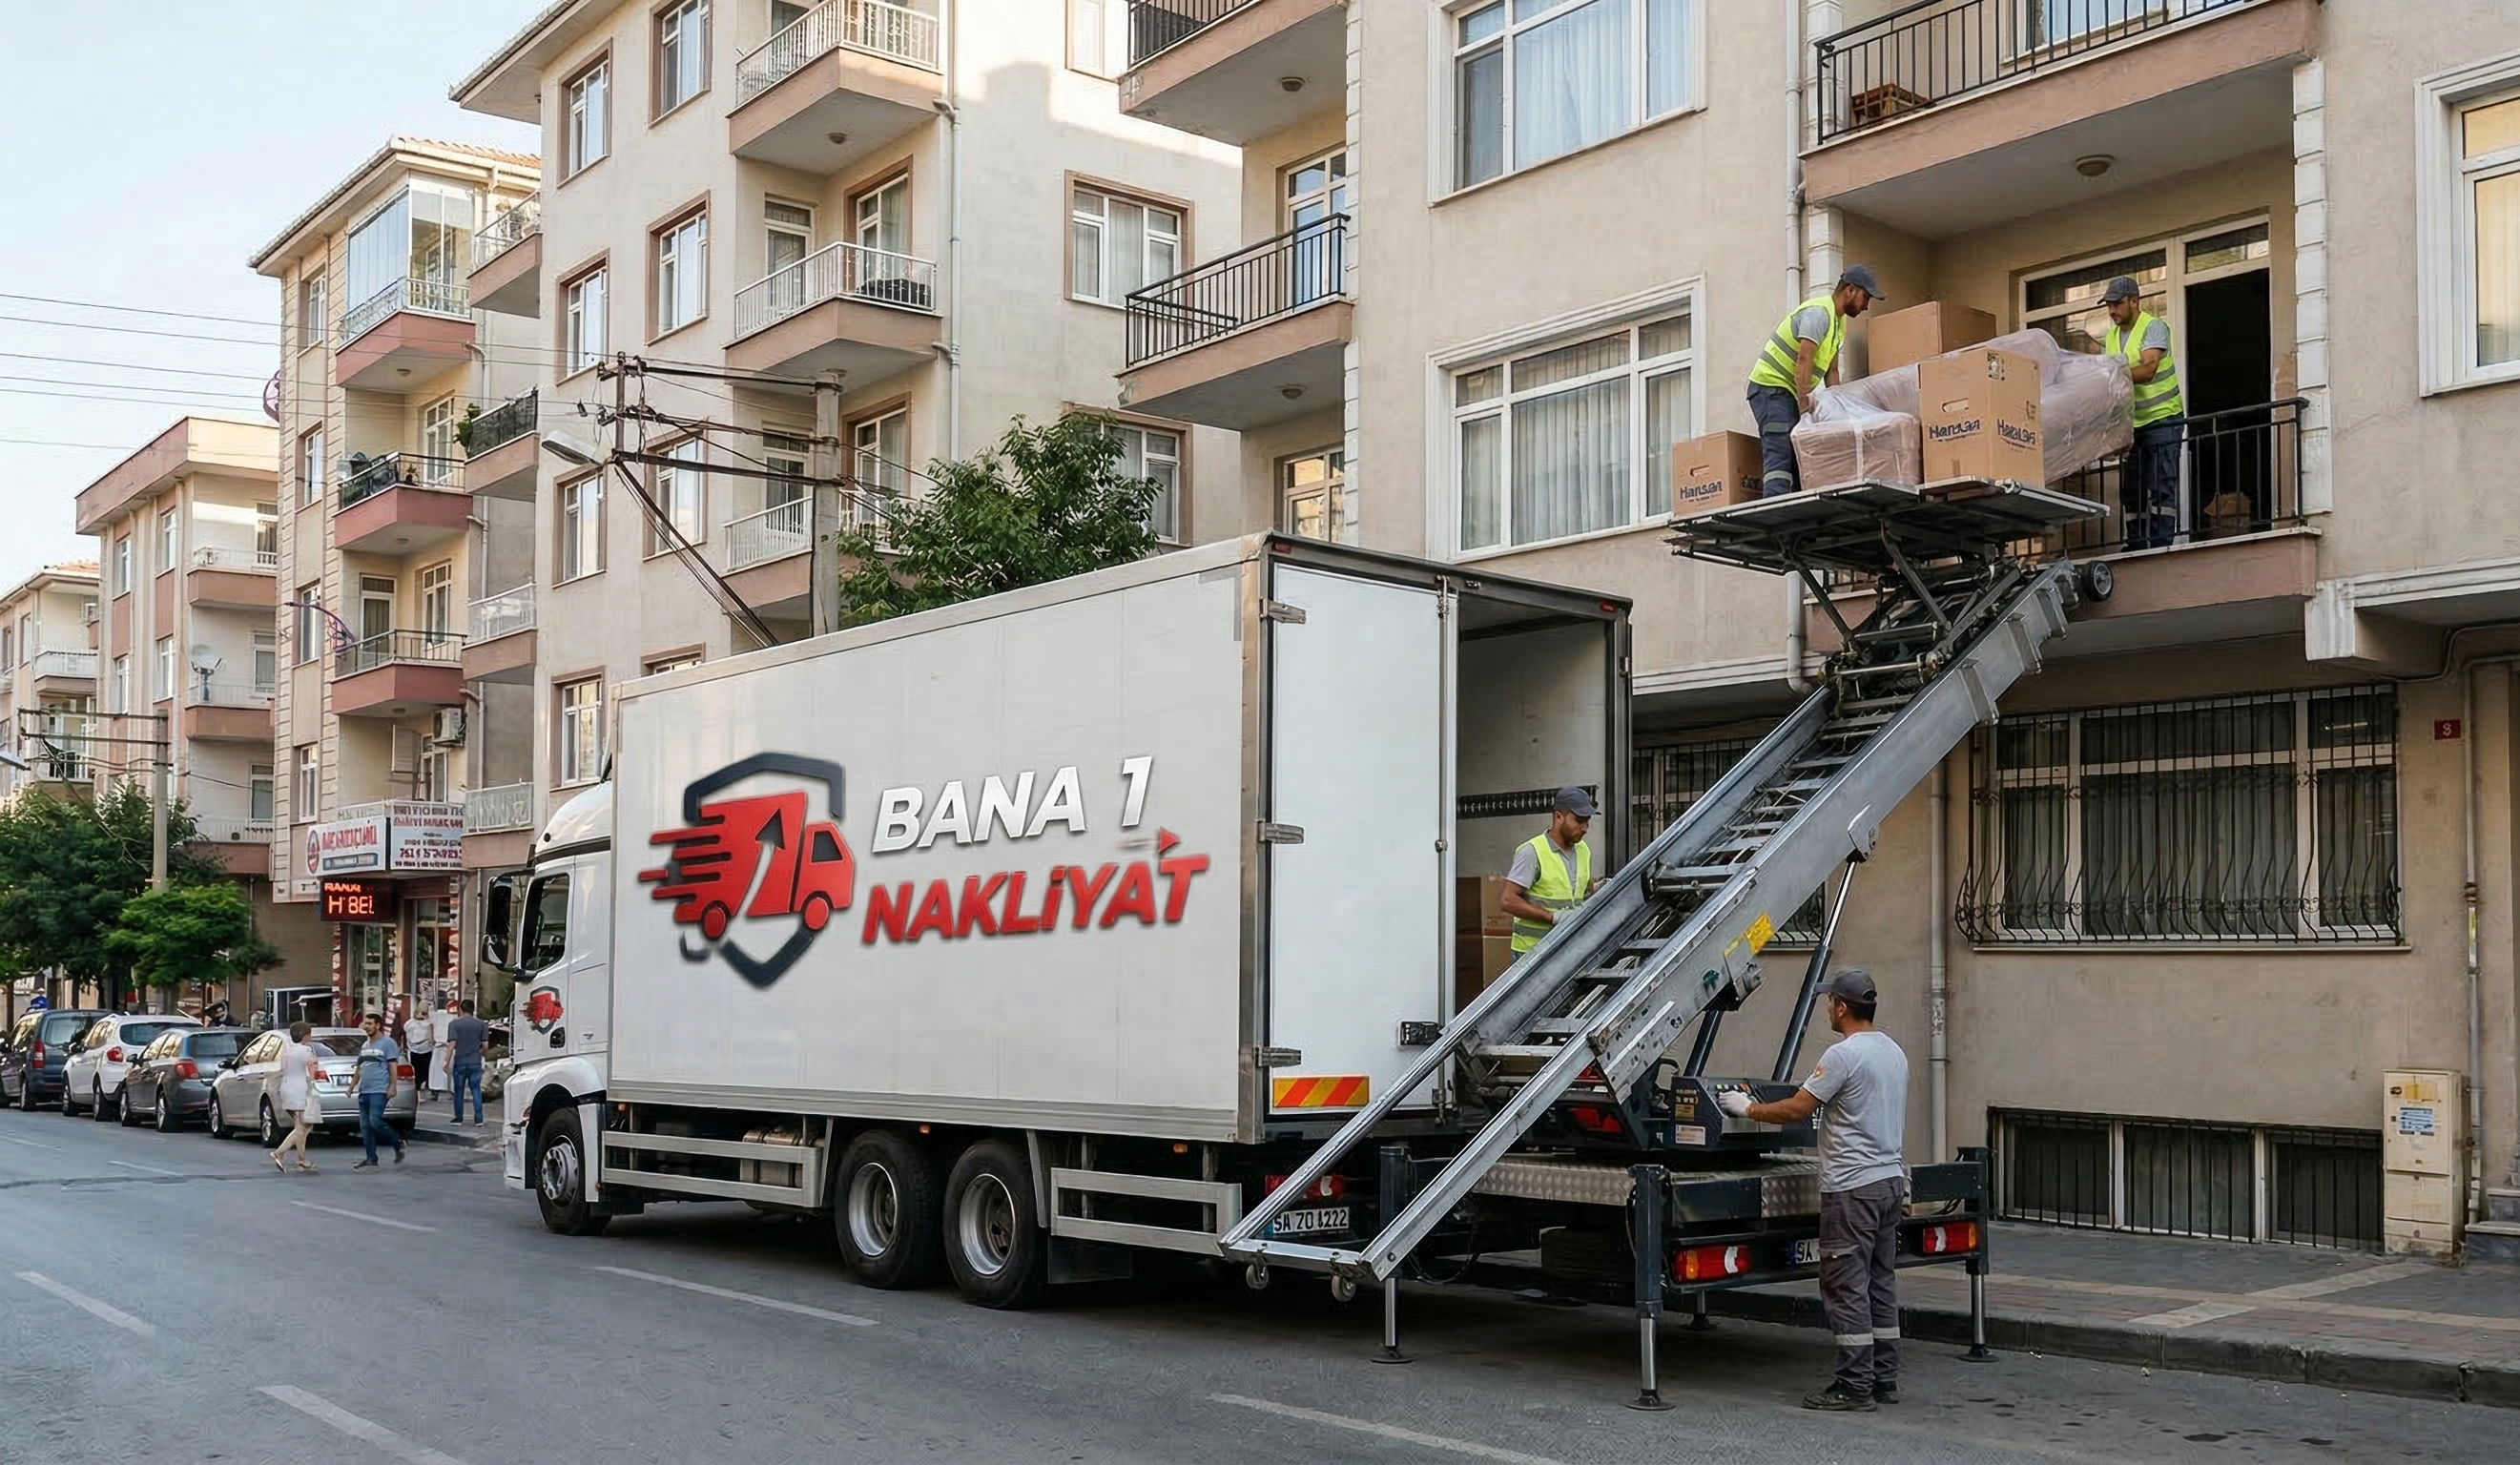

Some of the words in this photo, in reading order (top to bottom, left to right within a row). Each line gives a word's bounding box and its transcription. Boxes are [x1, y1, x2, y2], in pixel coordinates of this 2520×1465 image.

[872, 766, 1085, 853] BANA
[1122, 755, 1152, 827] 1
[862, 854, 1210, 943] NAKLİYAT
